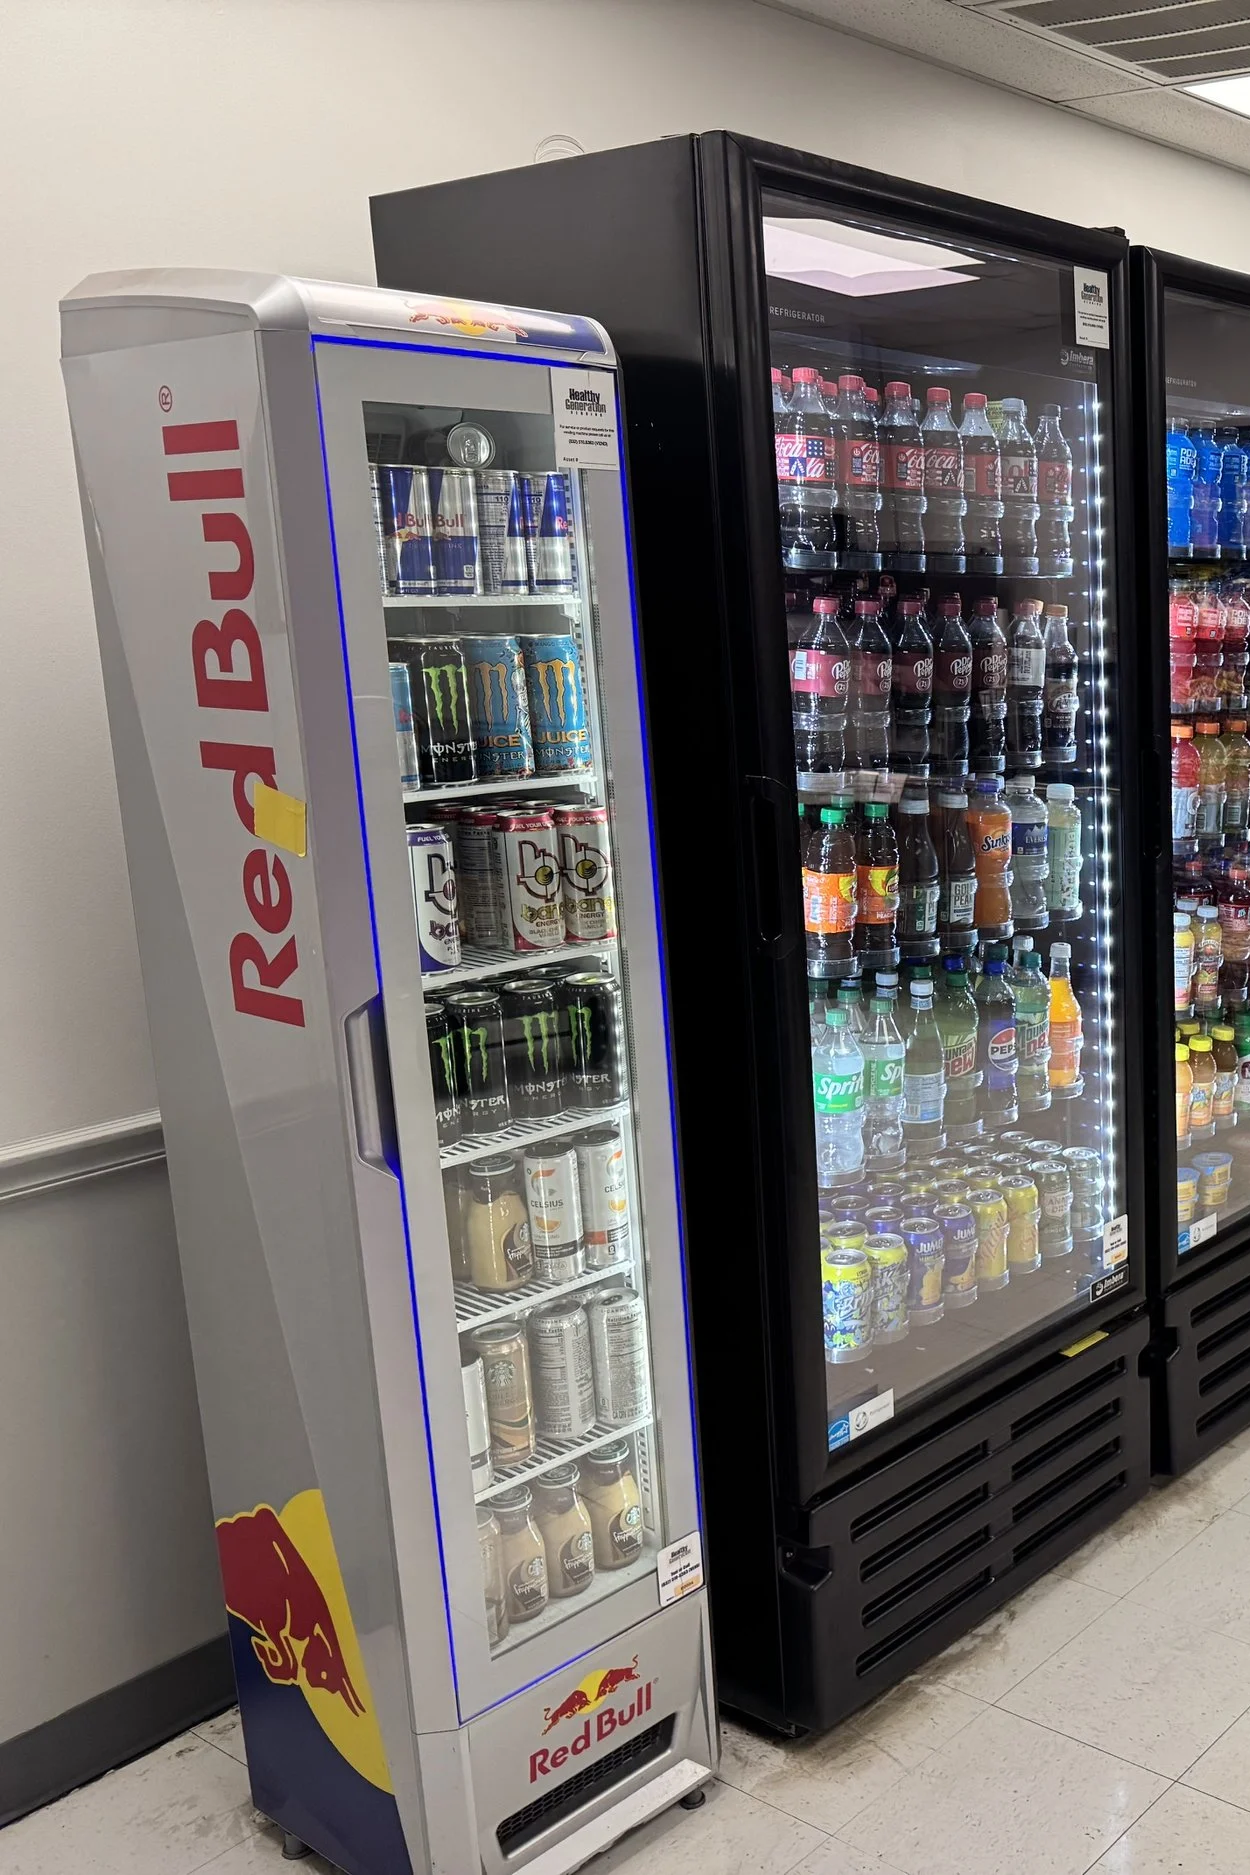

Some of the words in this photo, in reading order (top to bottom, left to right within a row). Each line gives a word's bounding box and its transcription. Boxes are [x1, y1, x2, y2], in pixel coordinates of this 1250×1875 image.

[769, 306, 825, 323] REFRIGERATOR
[569, 388, 600, 403] Healthy
[565, 399, 607, 413] Generation
[435, 514, 464, 528] Bull
[162, 419, 270, 713] Bull
[537, 730, 586, 744] JUICE
[200, 741, 306, 1028] Red
[429, 919, 460, 942] ban
[604, 1183, 625, 1194] CELS
[530, 1198, 564, 1208] CELSIUS
[530, 1718, 591, 1783] Red
[597, 1682, 652, 1742] Bull
